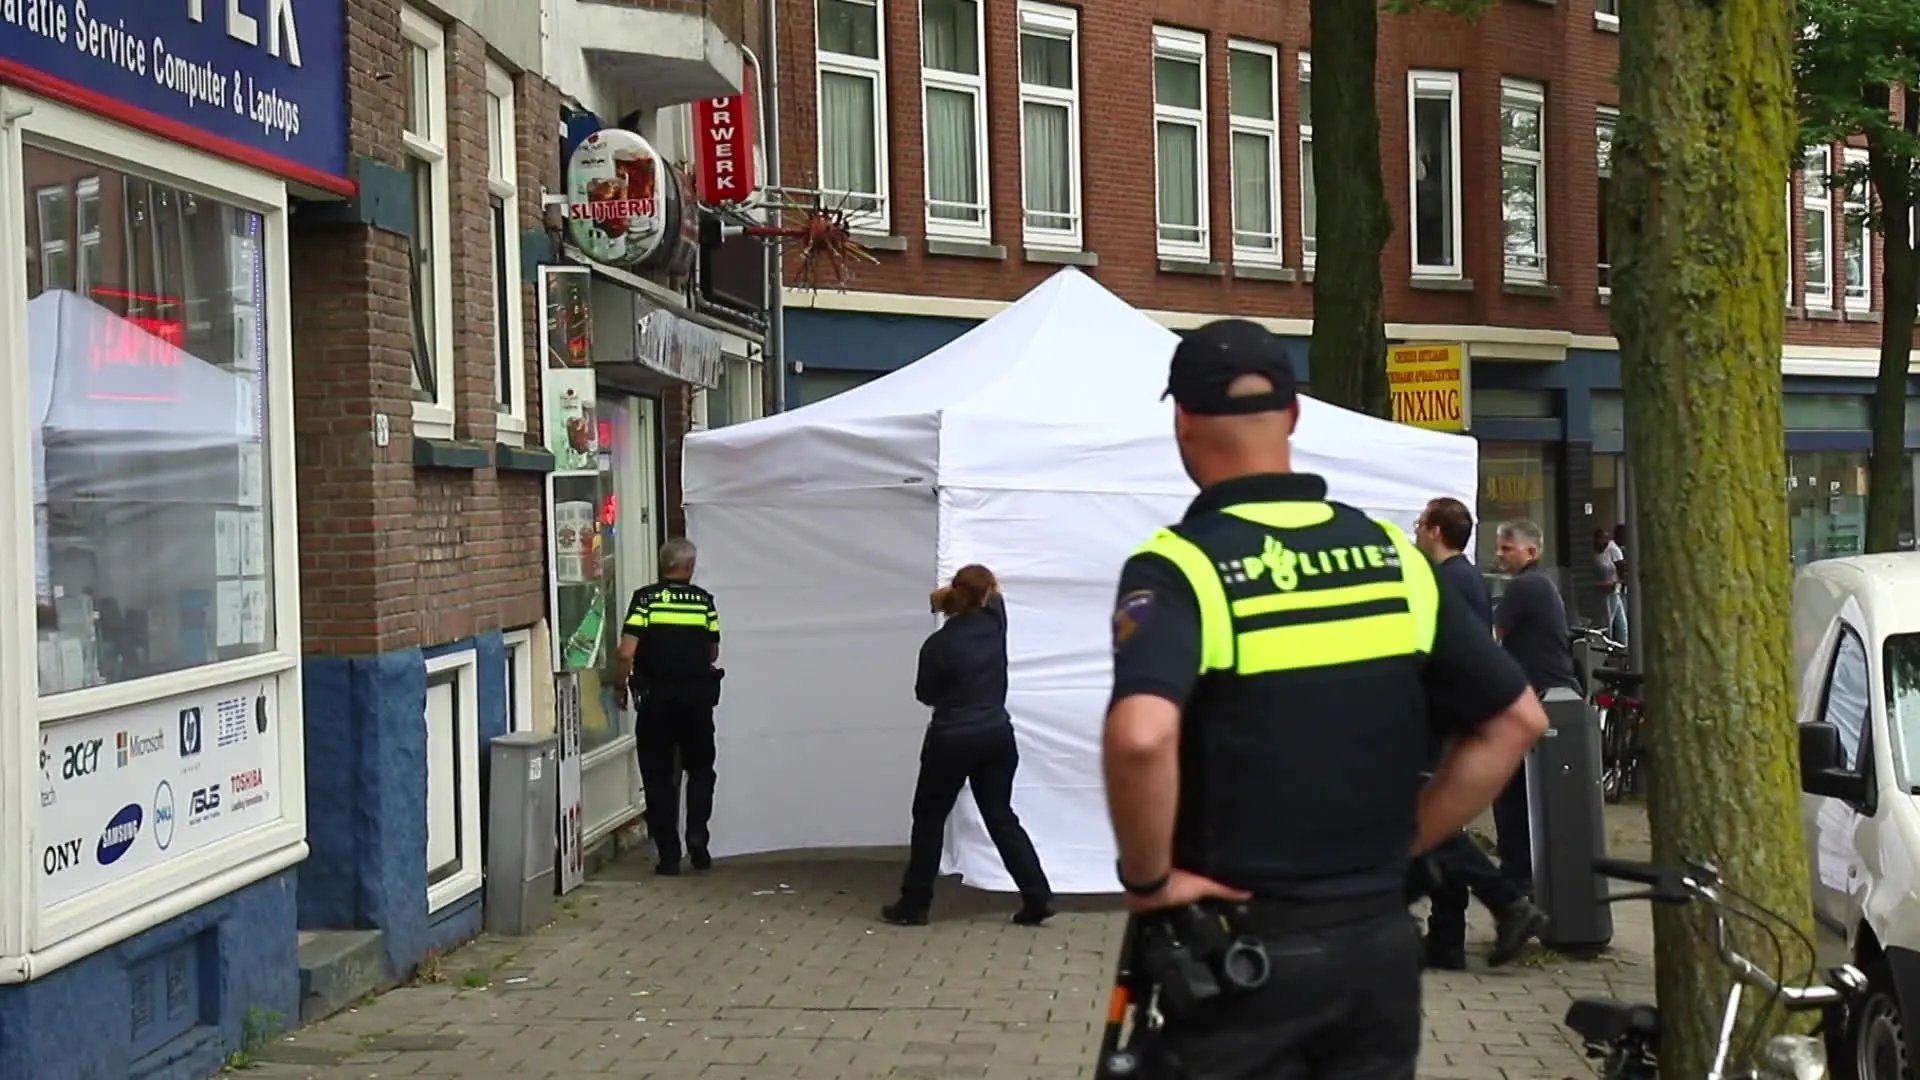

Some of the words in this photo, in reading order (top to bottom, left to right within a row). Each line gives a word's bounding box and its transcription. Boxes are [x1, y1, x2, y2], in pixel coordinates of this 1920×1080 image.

[0, 0, 67, 43] aratie
[75, 0, 146, 76] Service
[153, 36, 226, 108] Computer
[233, 70, 243, 115] &
[249, 77, 299, 141] Laptops
[710, 97, 735, 190] URWERK
[571, 199, 655, 221] SLIJTERIJ
[1392, 389, 1460, 423] INXING
[63, 738, 103, 780] acer
[189, 784, 220, 817] ASUS
[43, 838, 82, 876] ONY
